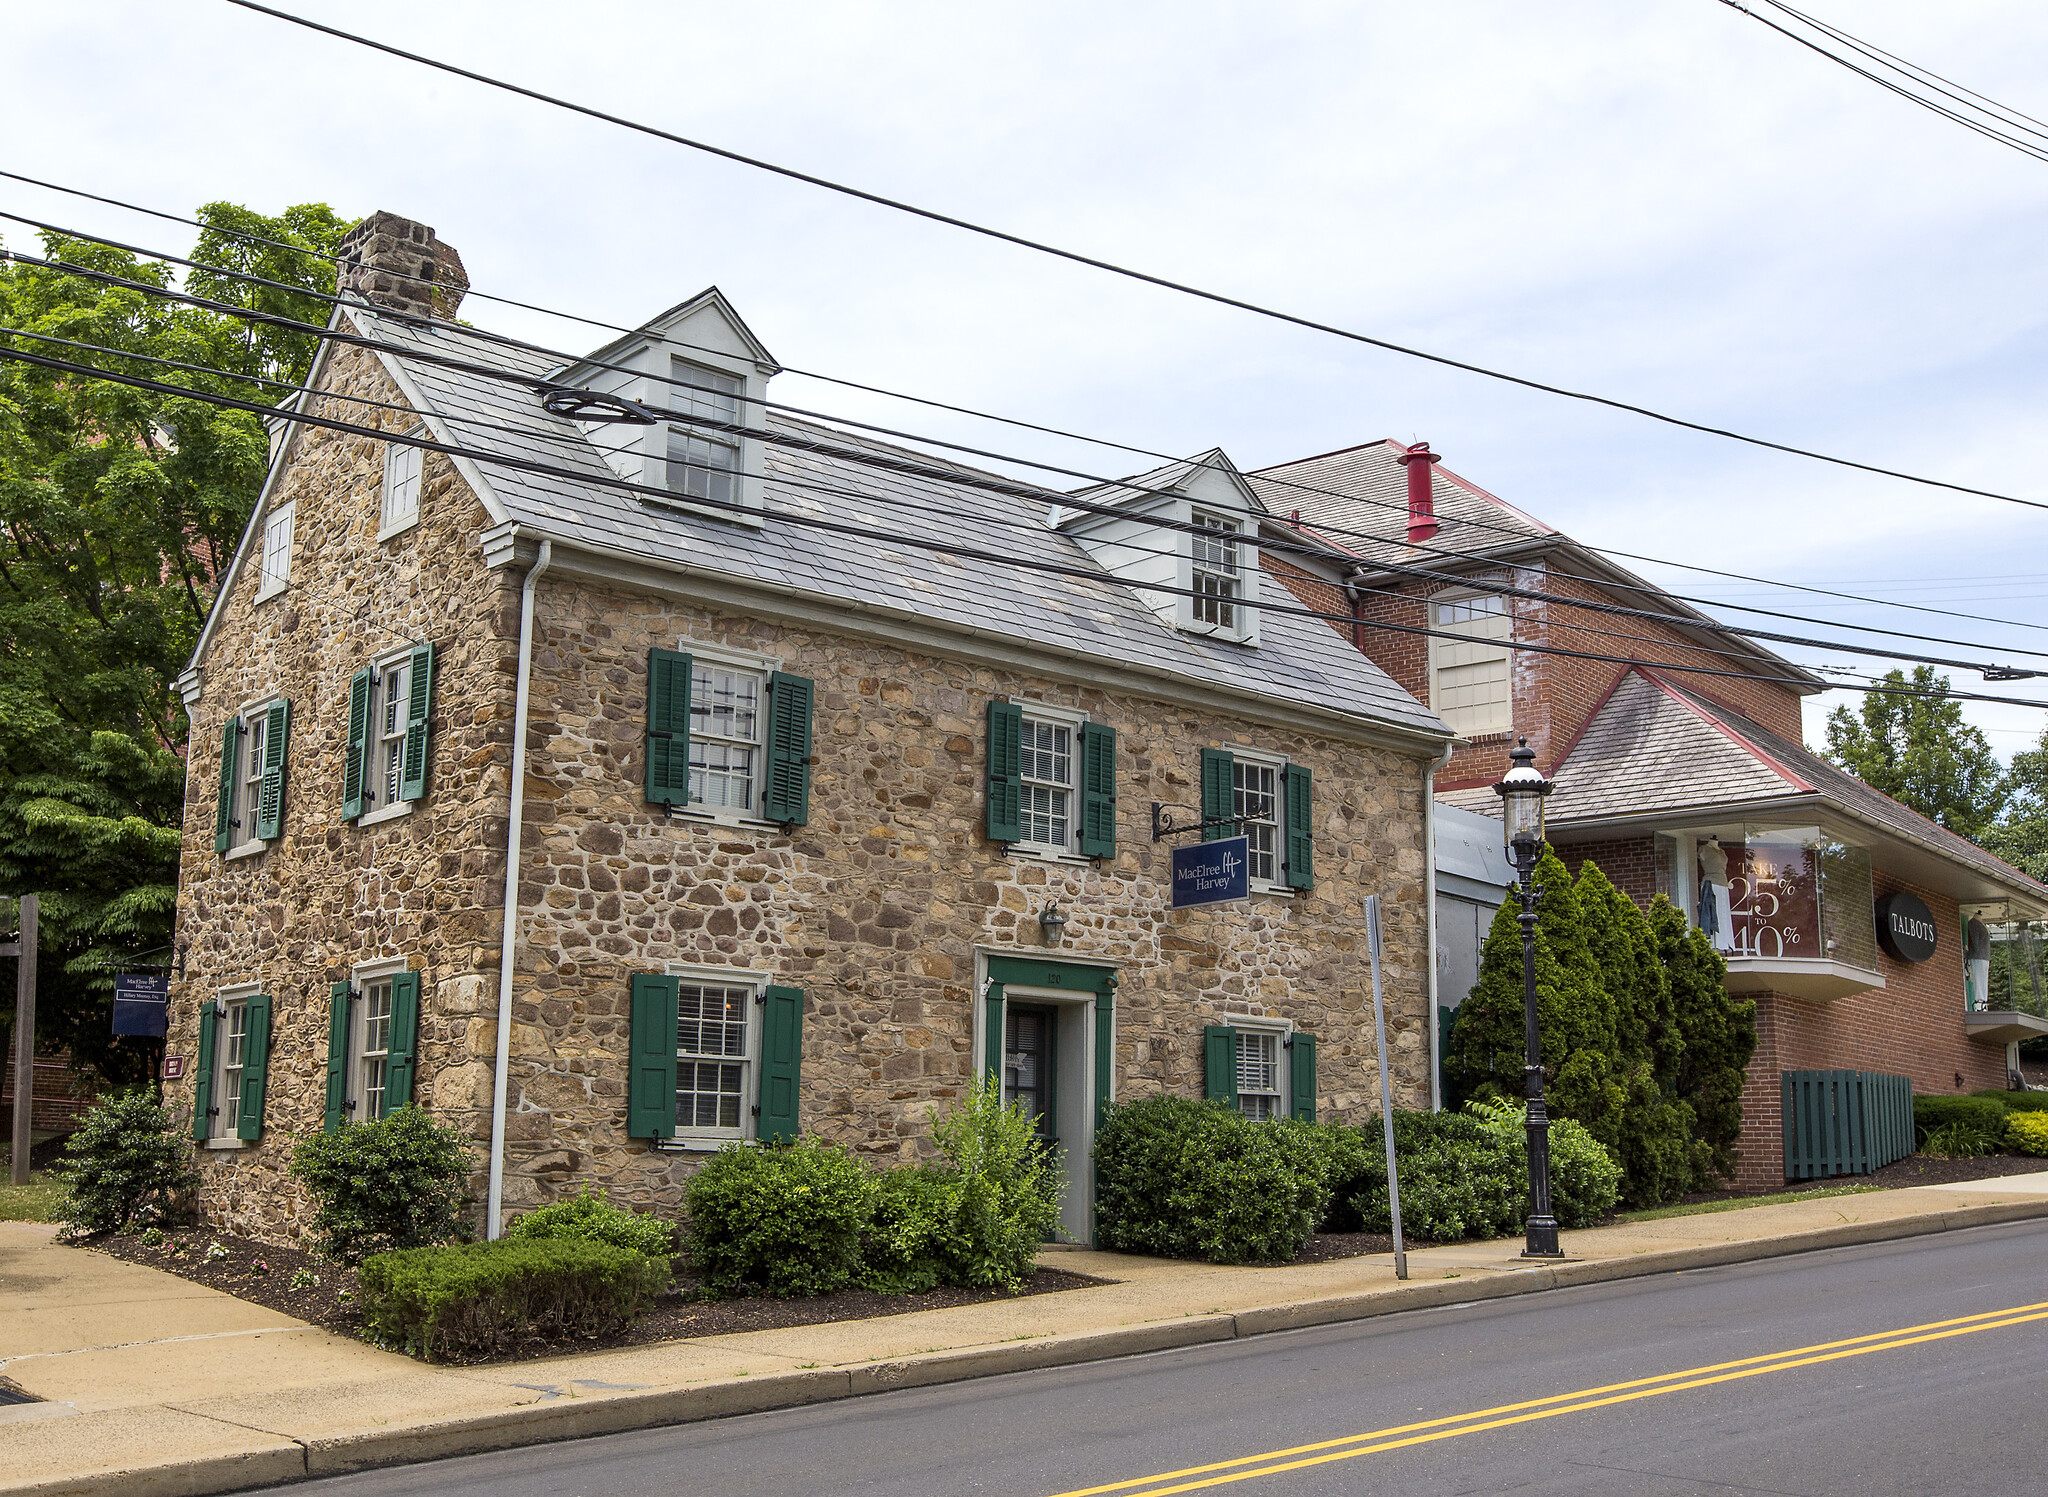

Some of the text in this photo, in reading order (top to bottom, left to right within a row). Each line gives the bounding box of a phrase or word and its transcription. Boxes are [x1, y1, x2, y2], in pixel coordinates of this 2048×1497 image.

[1178, 864, 1221, 881] MacElree
[1738, 862, 1778, 876] TAKE
[1196, 878, 1230, 890] Harvey
[1727, 877, 1797, 917] 25%
[1755, 917, 1767, 926] TO
[1891, 913, 1934, 942] TALBOTS
[1048, 973, 1061, 985] 120
